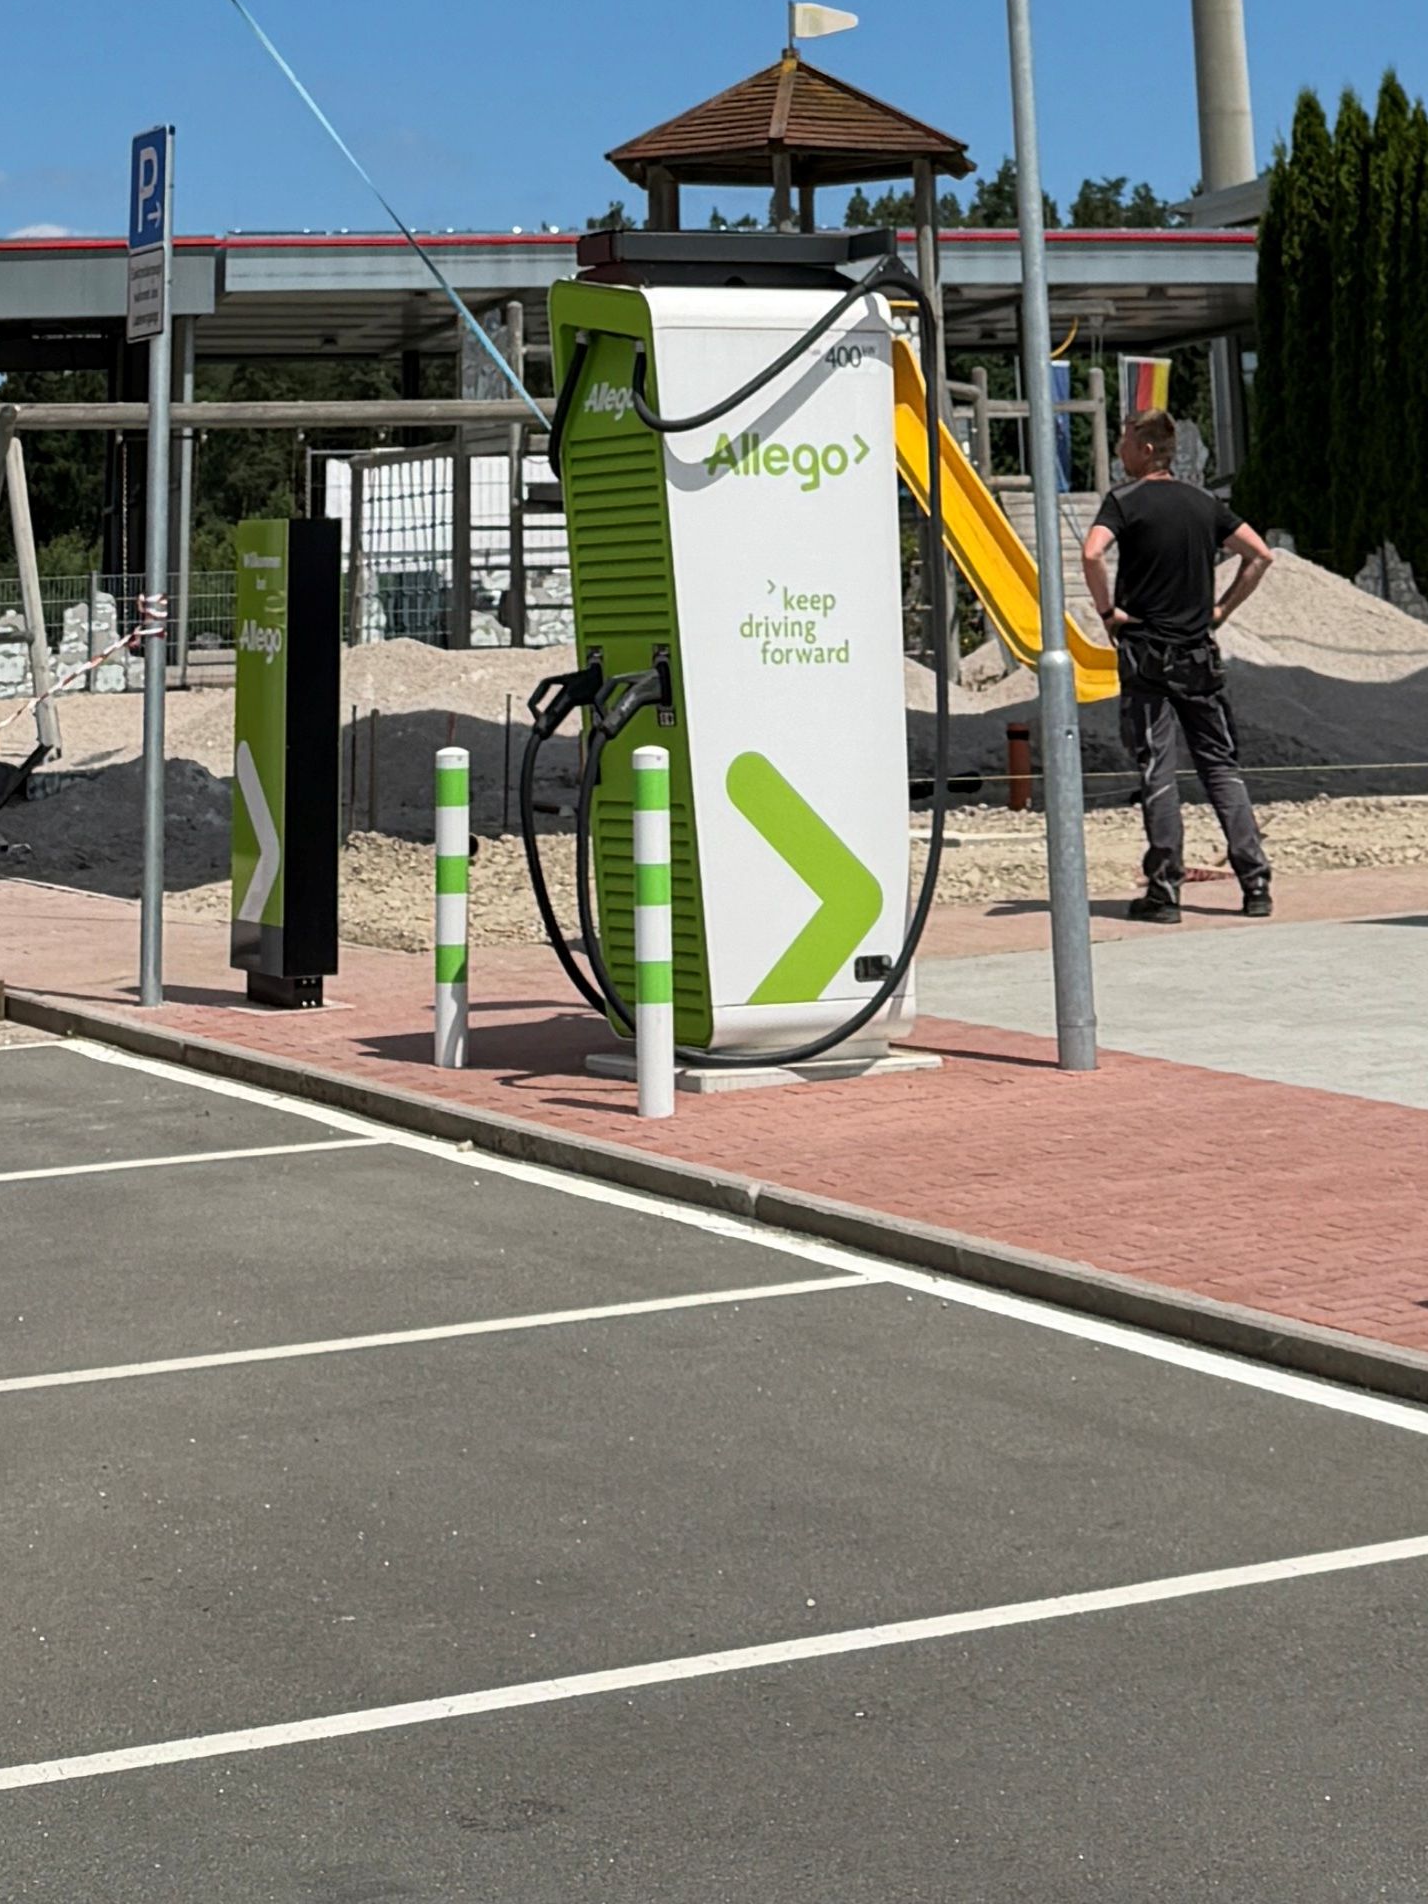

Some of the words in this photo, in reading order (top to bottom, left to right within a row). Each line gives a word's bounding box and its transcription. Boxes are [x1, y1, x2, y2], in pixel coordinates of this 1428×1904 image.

[137, 145, 158, 233] P
[825, 345, 862, 368] 400
[702, 433, 849, 491] Allego
[783, 587, 836, 623] keep
[239, 619, 282, 664] Allego
[739, 614, 817, 644] driving
[760, 640, 850, 665] forward
